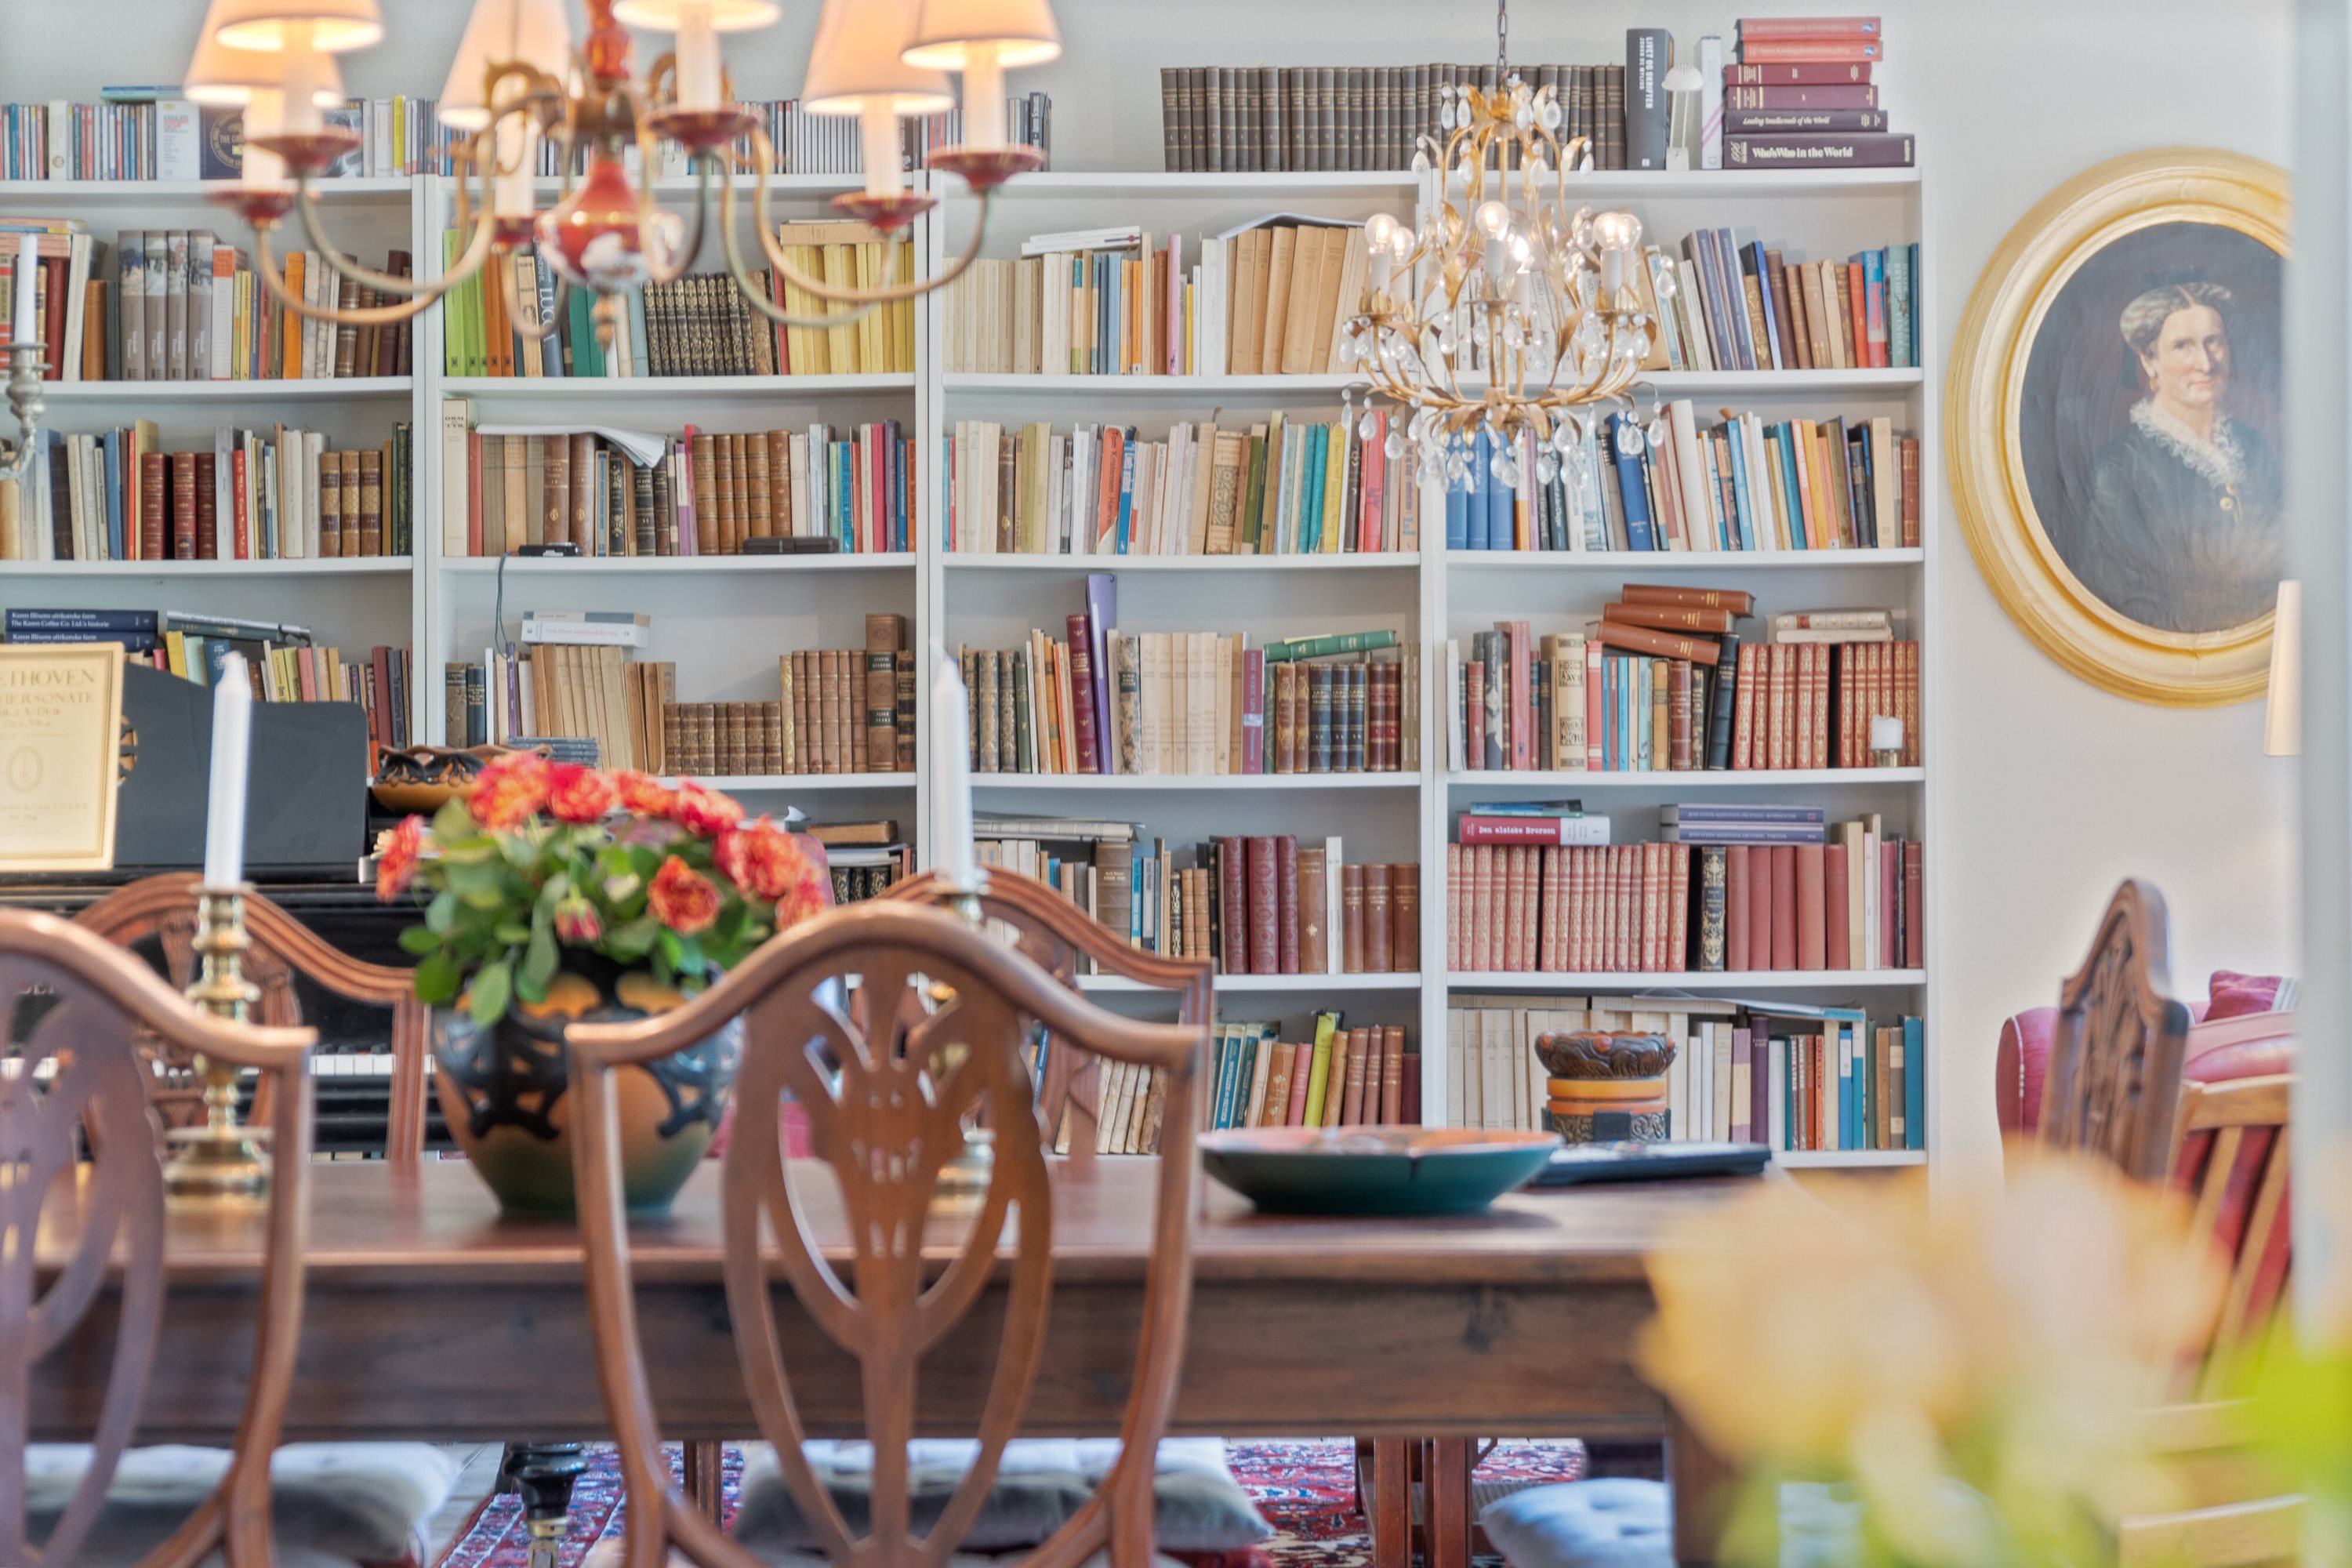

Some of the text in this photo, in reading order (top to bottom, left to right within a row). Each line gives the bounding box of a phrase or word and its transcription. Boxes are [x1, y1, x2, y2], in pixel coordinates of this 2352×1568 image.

[1645, 36, 1653, 109] LIVET OG SKRIFTER
[1797, 117, 1803, 125] of
[1813, 116, 1830, 125] World
[1796, 147, 1806, 158] in
[1806, 147, 1824, 158] the
[1824, 146, 1853, 158] World
[1108, 451, 1116, 493] Kristensen
[1106, 497, 1115, 527] Hærvæ
[12, 612, 30, 620] Karen
[30, 612, 51, 620] Blixens
